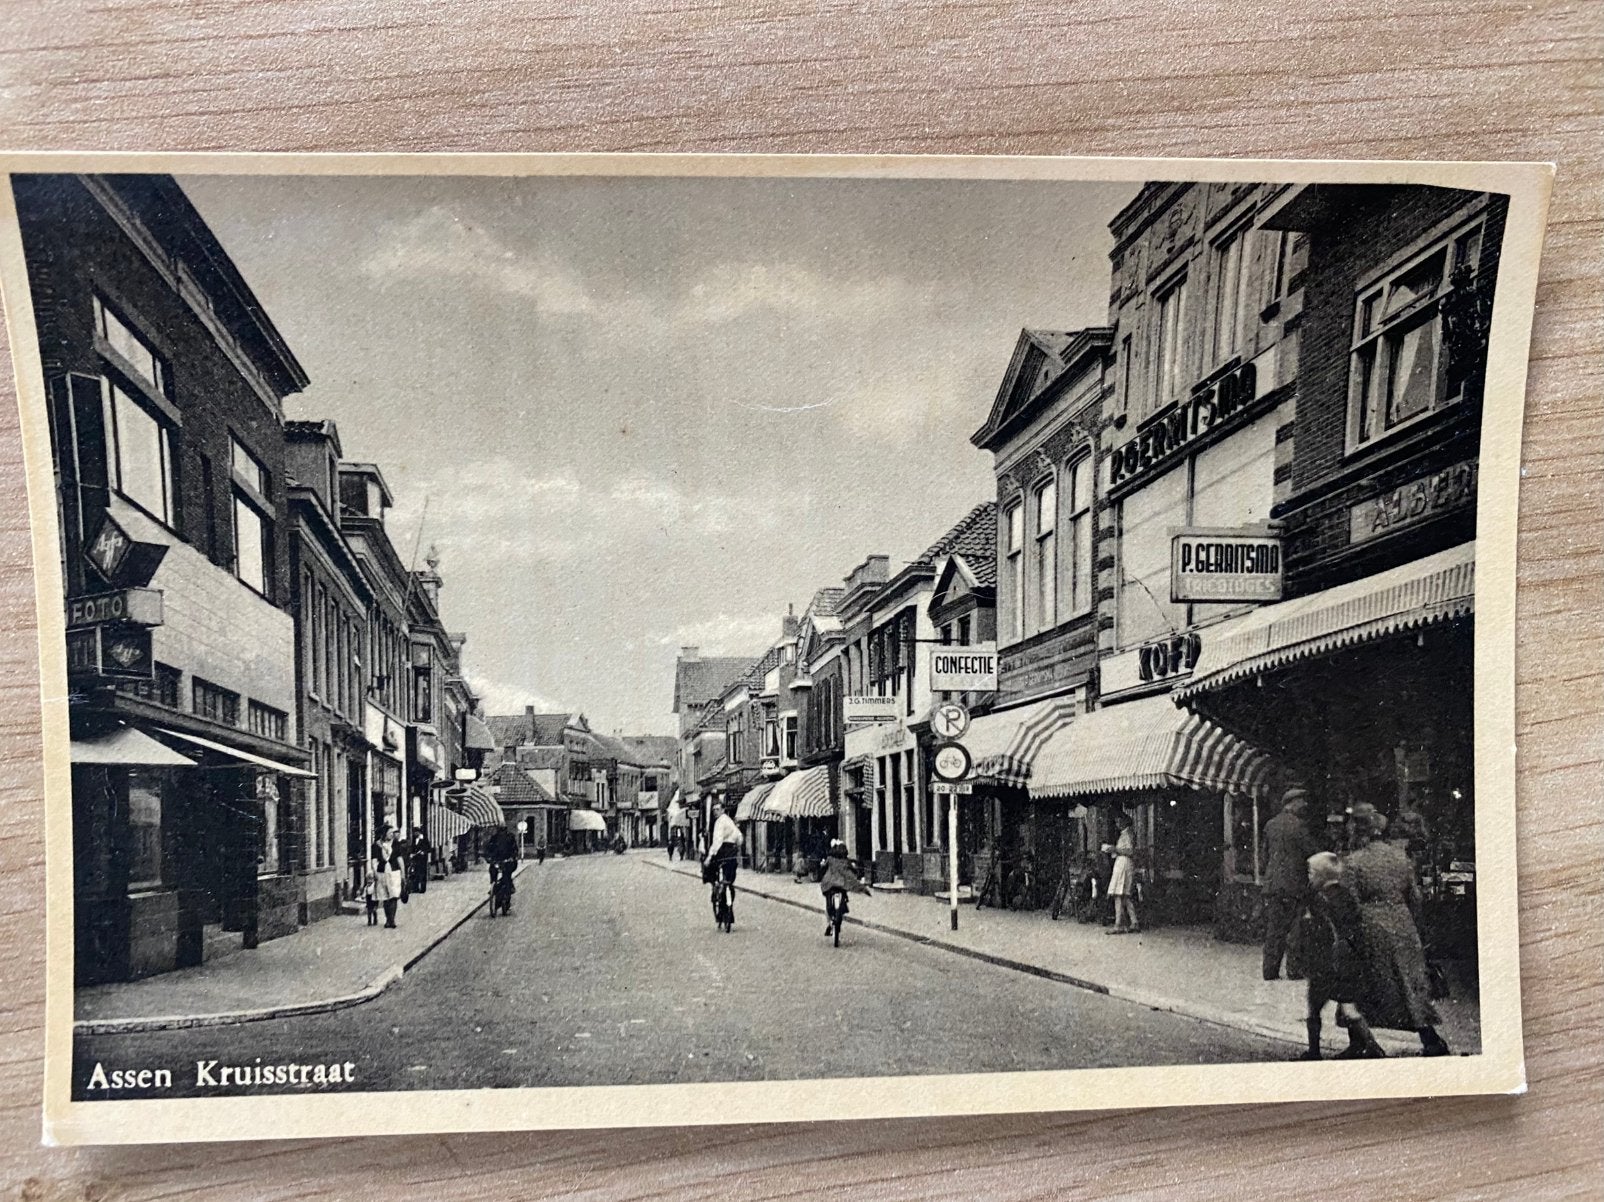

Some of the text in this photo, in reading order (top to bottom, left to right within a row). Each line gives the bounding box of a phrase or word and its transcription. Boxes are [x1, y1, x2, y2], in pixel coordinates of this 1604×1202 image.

[72, 597, 124, 624] FOTO
[935, 655, 995, 675] CONFECTIE
[86, 1057, 356, 1090] Assen Kruisstraat
